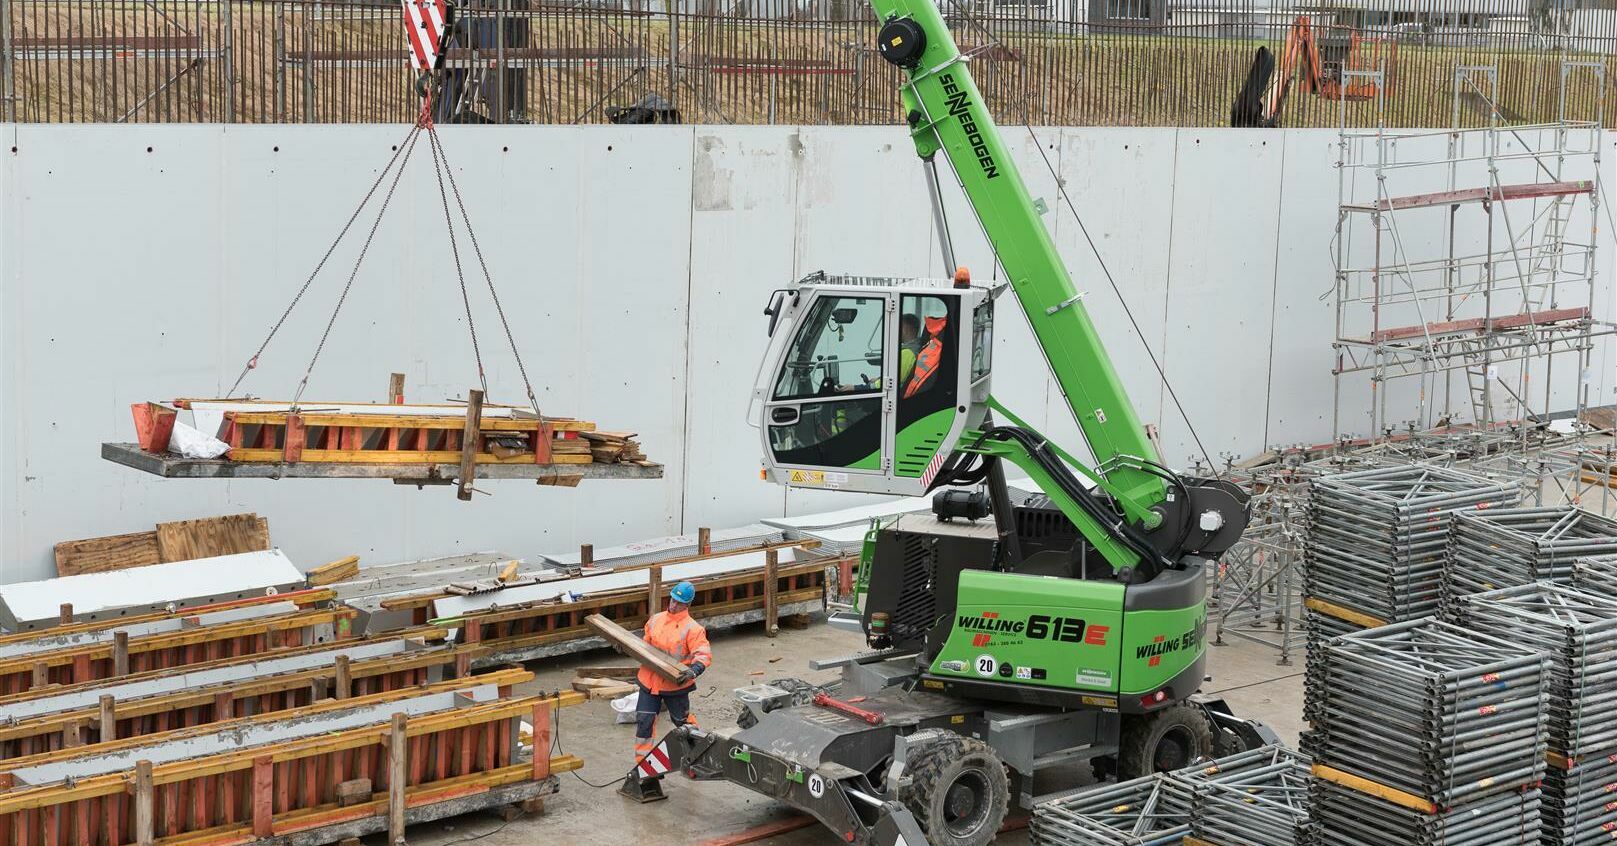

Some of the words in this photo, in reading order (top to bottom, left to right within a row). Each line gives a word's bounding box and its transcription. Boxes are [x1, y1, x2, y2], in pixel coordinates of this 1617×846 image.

[939, 73, 999, 179] SENNEBOGEN
[959, 615, 1025, 633] WILLING
[1026, 615, 1109, 646] 613E
[1136, 638, 1180, 659] WILLING
[979, 659, 993, 673] 20
[811, 778, 821, 793] 20
